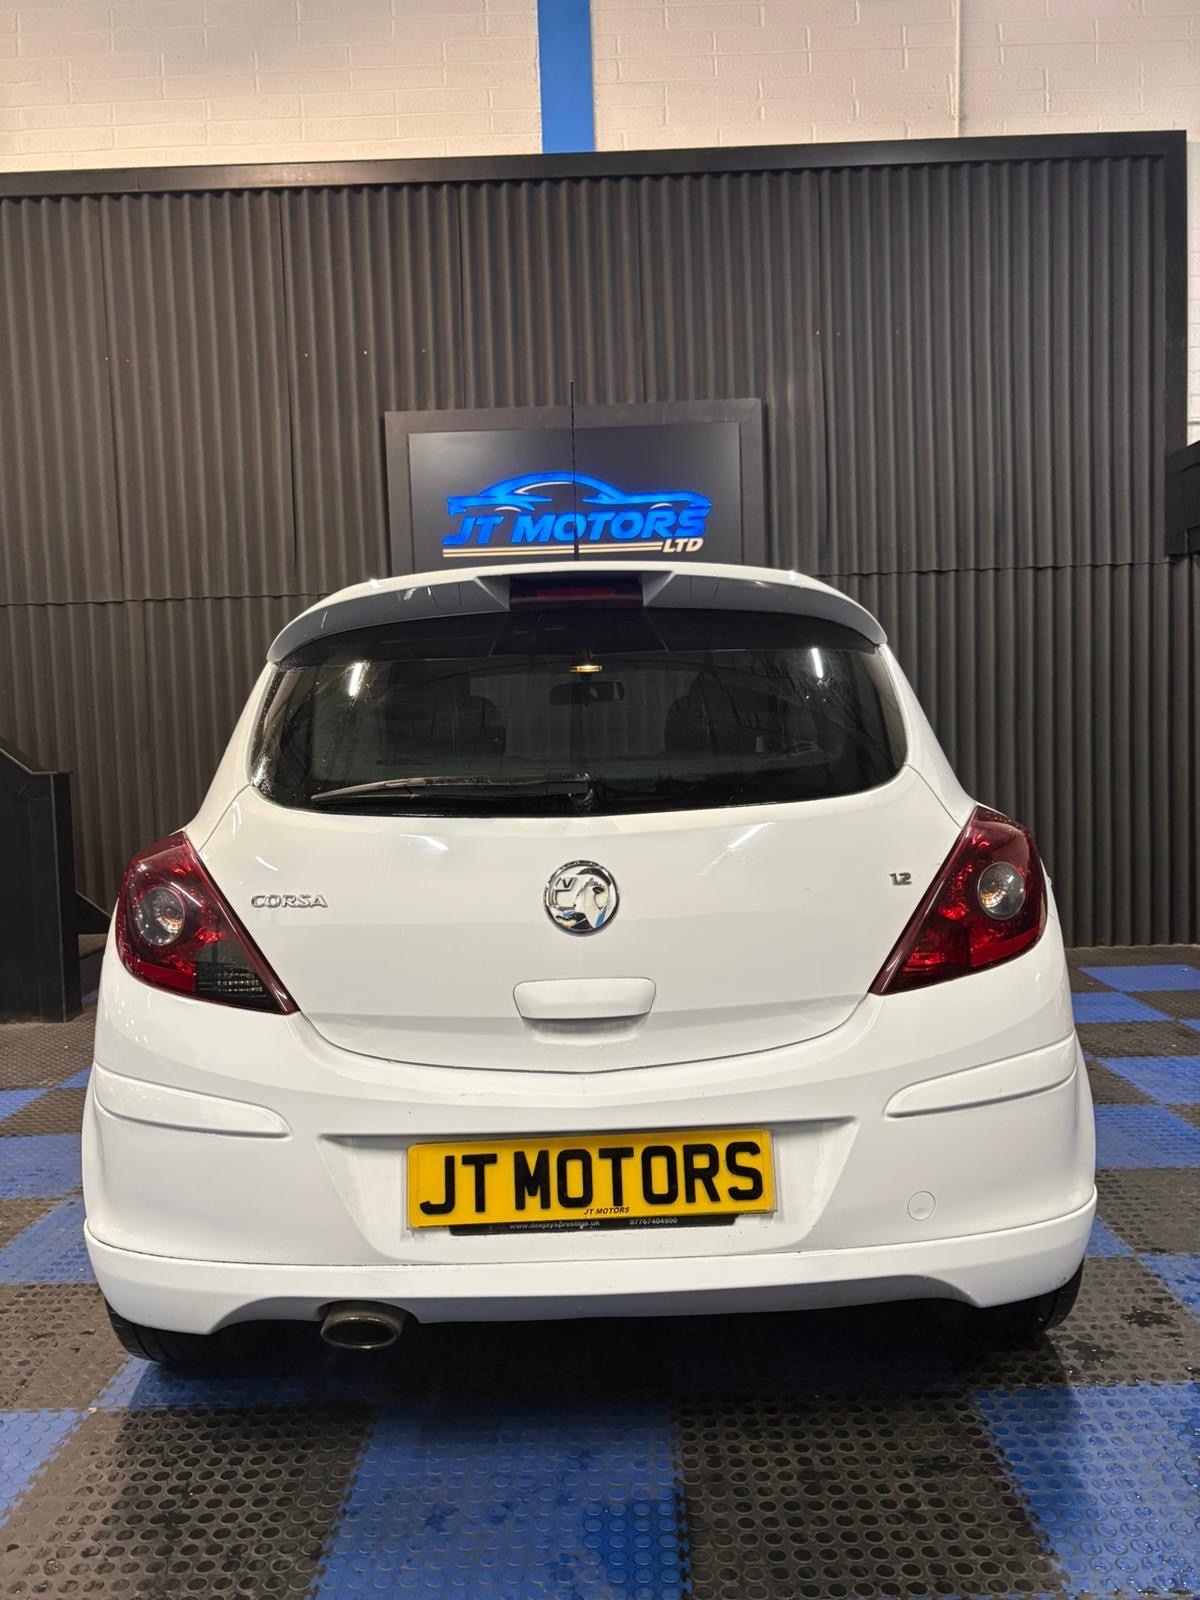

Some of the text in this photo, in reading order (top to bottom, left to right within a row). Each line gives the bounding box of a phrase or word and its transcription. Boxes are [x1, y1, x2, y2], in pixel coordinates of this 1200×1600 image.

[442, 505, 712, 545] JT MOTORS
[662, 537, 704, 553] LTD
[251, 894, 329, 908] CORSA
[419, 1141, 764, 1216] JT MOTORS
[595, 1206, 630, 1215] MOTORS
